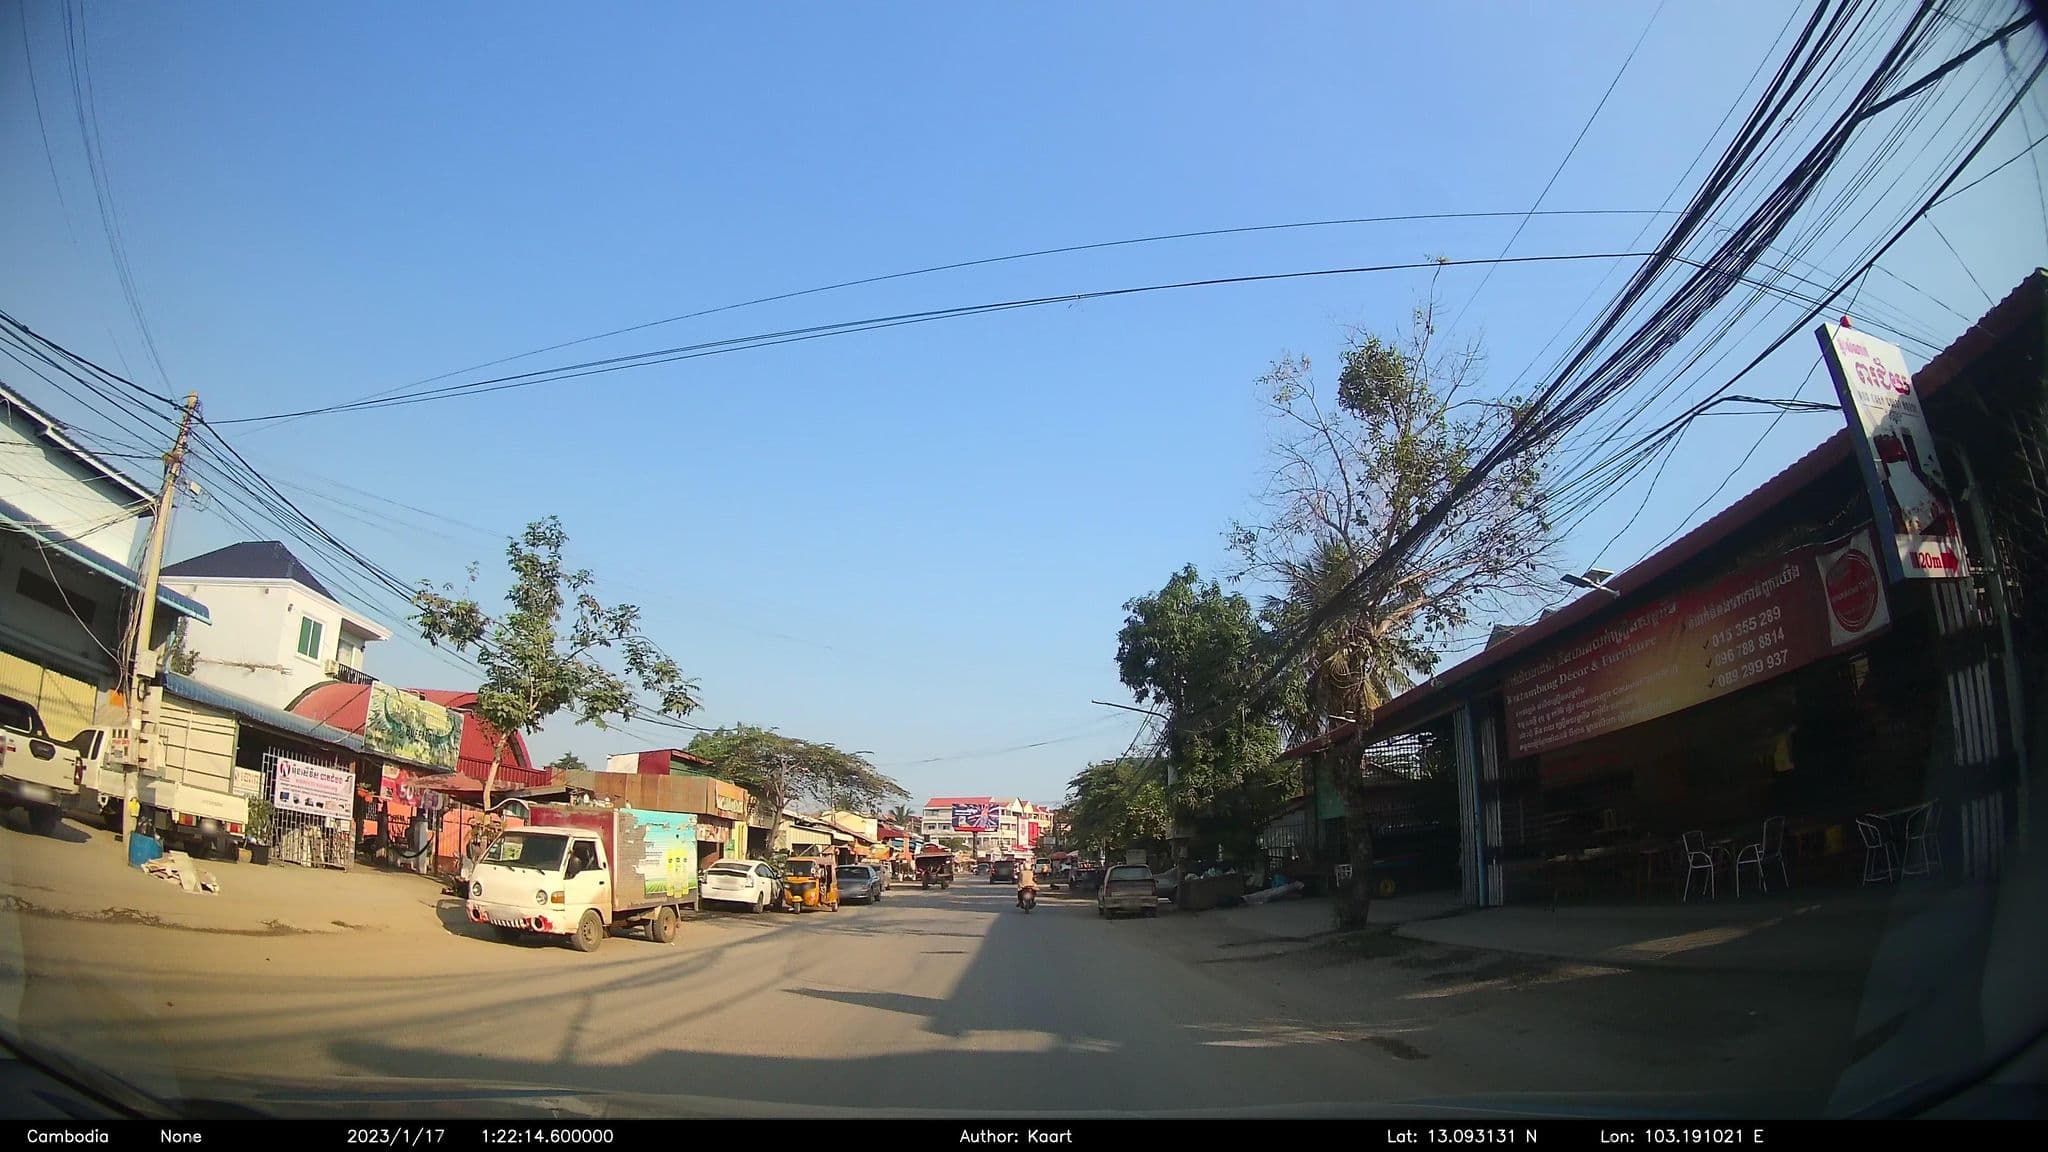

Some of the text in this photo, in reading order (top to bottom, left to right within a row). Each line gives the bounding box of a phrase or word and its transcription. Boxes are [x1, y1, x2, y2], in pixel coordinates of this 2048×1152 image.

[1918, 551, 1943, 569] 20m
[1759, 606, 1781, 627] 289
[1715, 648, 1735, 666] 096
[1758, 626, 1785, 649] 8814
[1741, 659, 1763, 680] 299
[1766, 648, 1788, 670] 937
